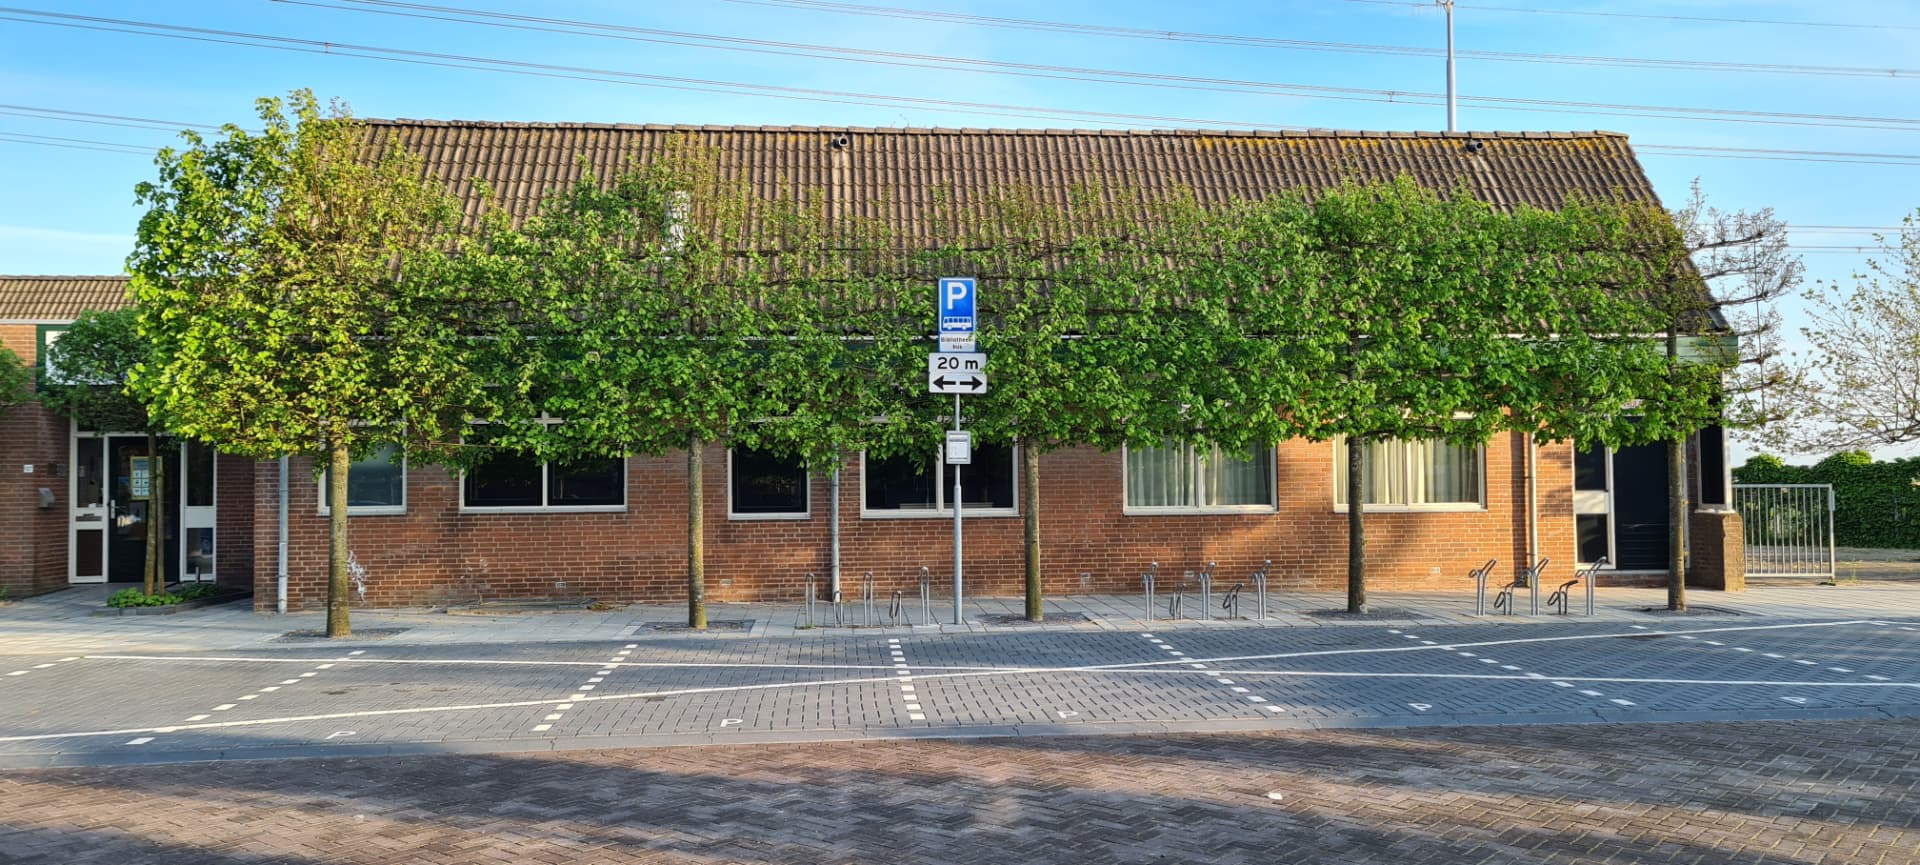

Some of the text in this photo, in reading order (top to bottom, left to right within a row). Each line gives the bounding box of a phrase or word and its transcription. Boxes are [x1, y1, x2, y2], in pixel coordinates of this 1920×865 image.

[947, 282, 967, 310] P
[937, 356, 979, 370] 20 m
[720, 718, 743, 727] P
[325, 731, 356, 740] P
